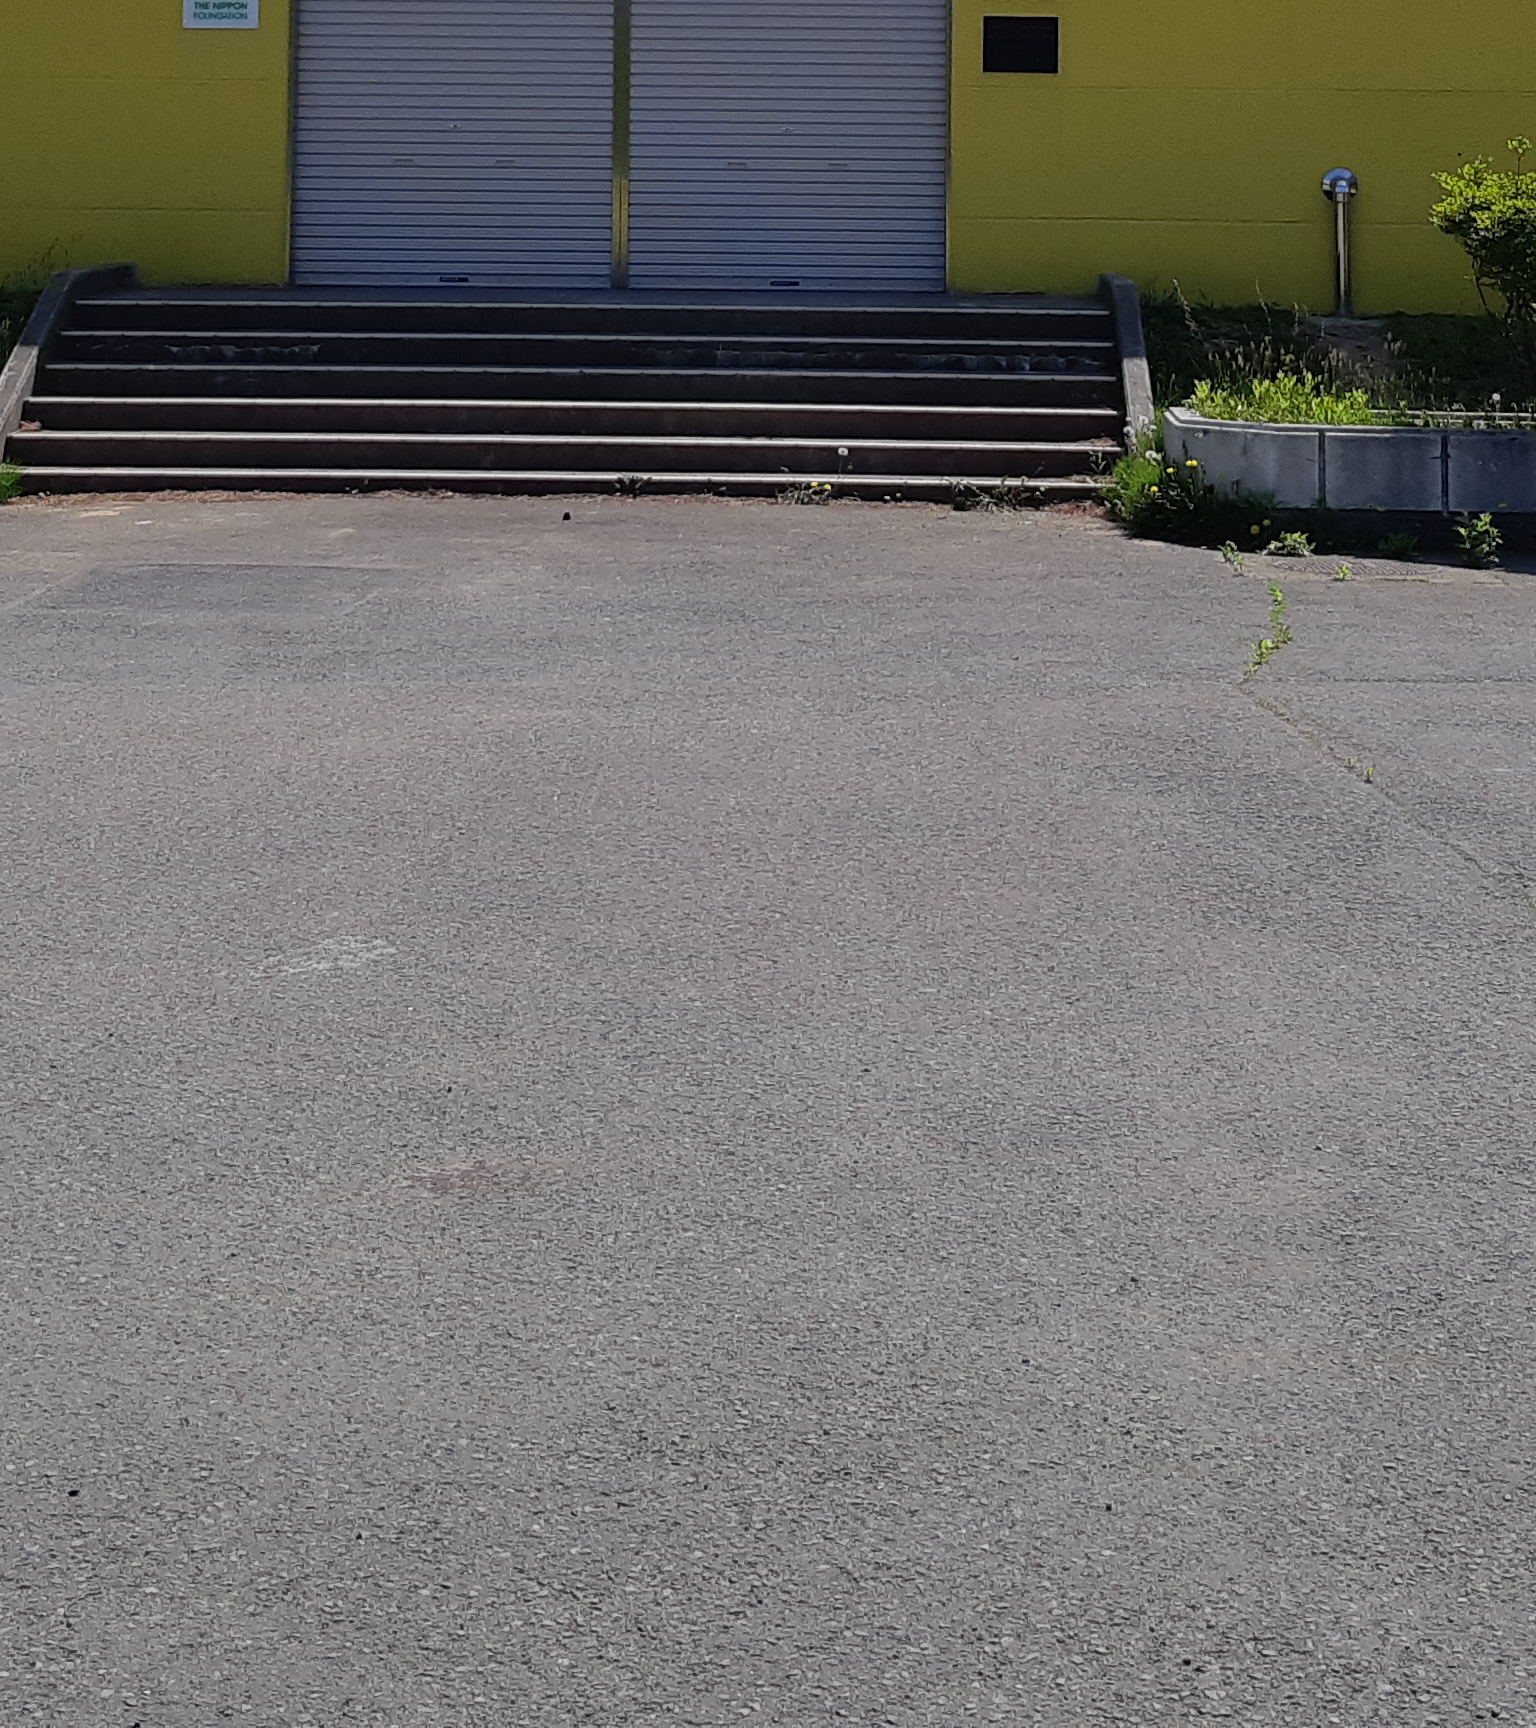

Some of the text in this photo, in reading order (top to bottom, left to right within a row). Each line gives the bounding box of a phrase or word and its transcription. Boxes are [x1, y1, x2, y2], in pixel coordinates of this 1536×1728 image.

[194, 1, 248, 10] THE NIPPON
[193, 12, 248, 20] FOUNDATION
